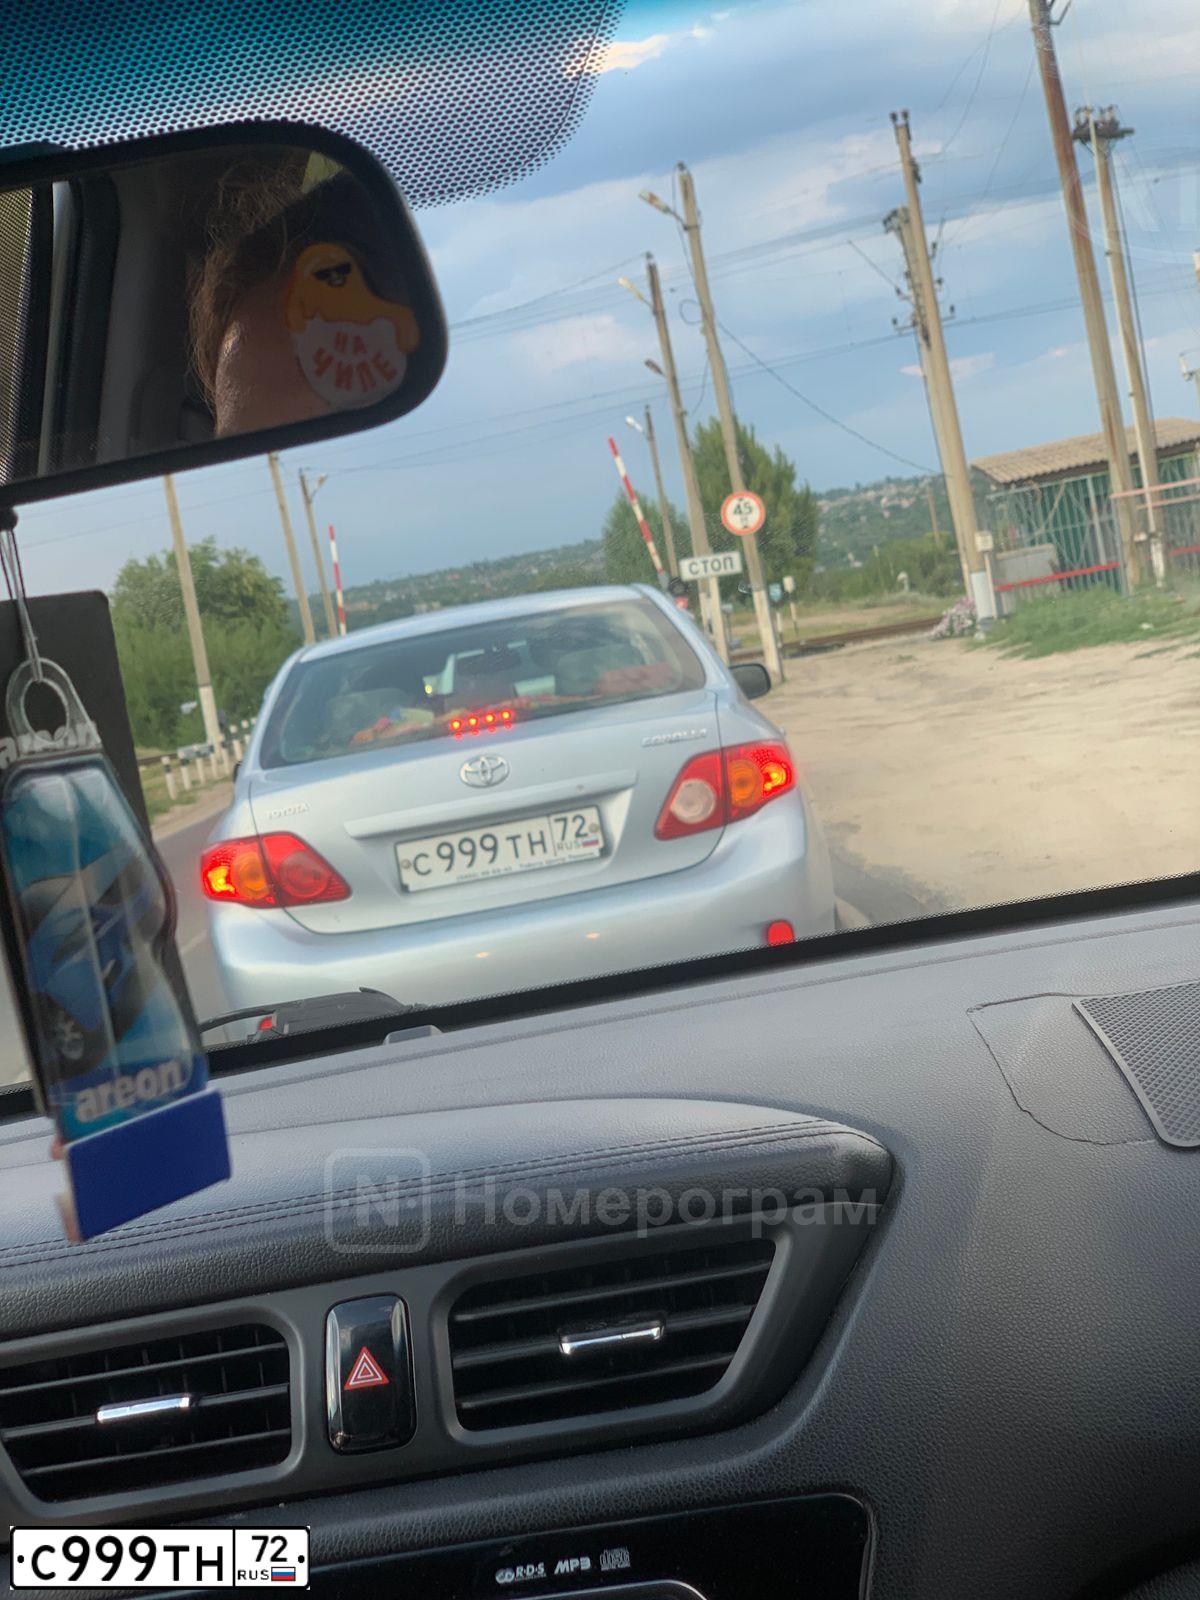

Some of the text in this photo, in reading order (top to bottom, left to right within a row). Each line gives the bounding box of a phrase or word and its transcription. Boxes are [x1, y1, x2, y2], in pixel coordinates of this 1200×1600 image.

[688, 556, 734, 575] СТОП
[264, 801, 310, 820] TOYOTA
[554, 814, 589, 841] 72
[76, 1059, 184, 1123] areon
[554, 1556, 592, 1574] MP3
